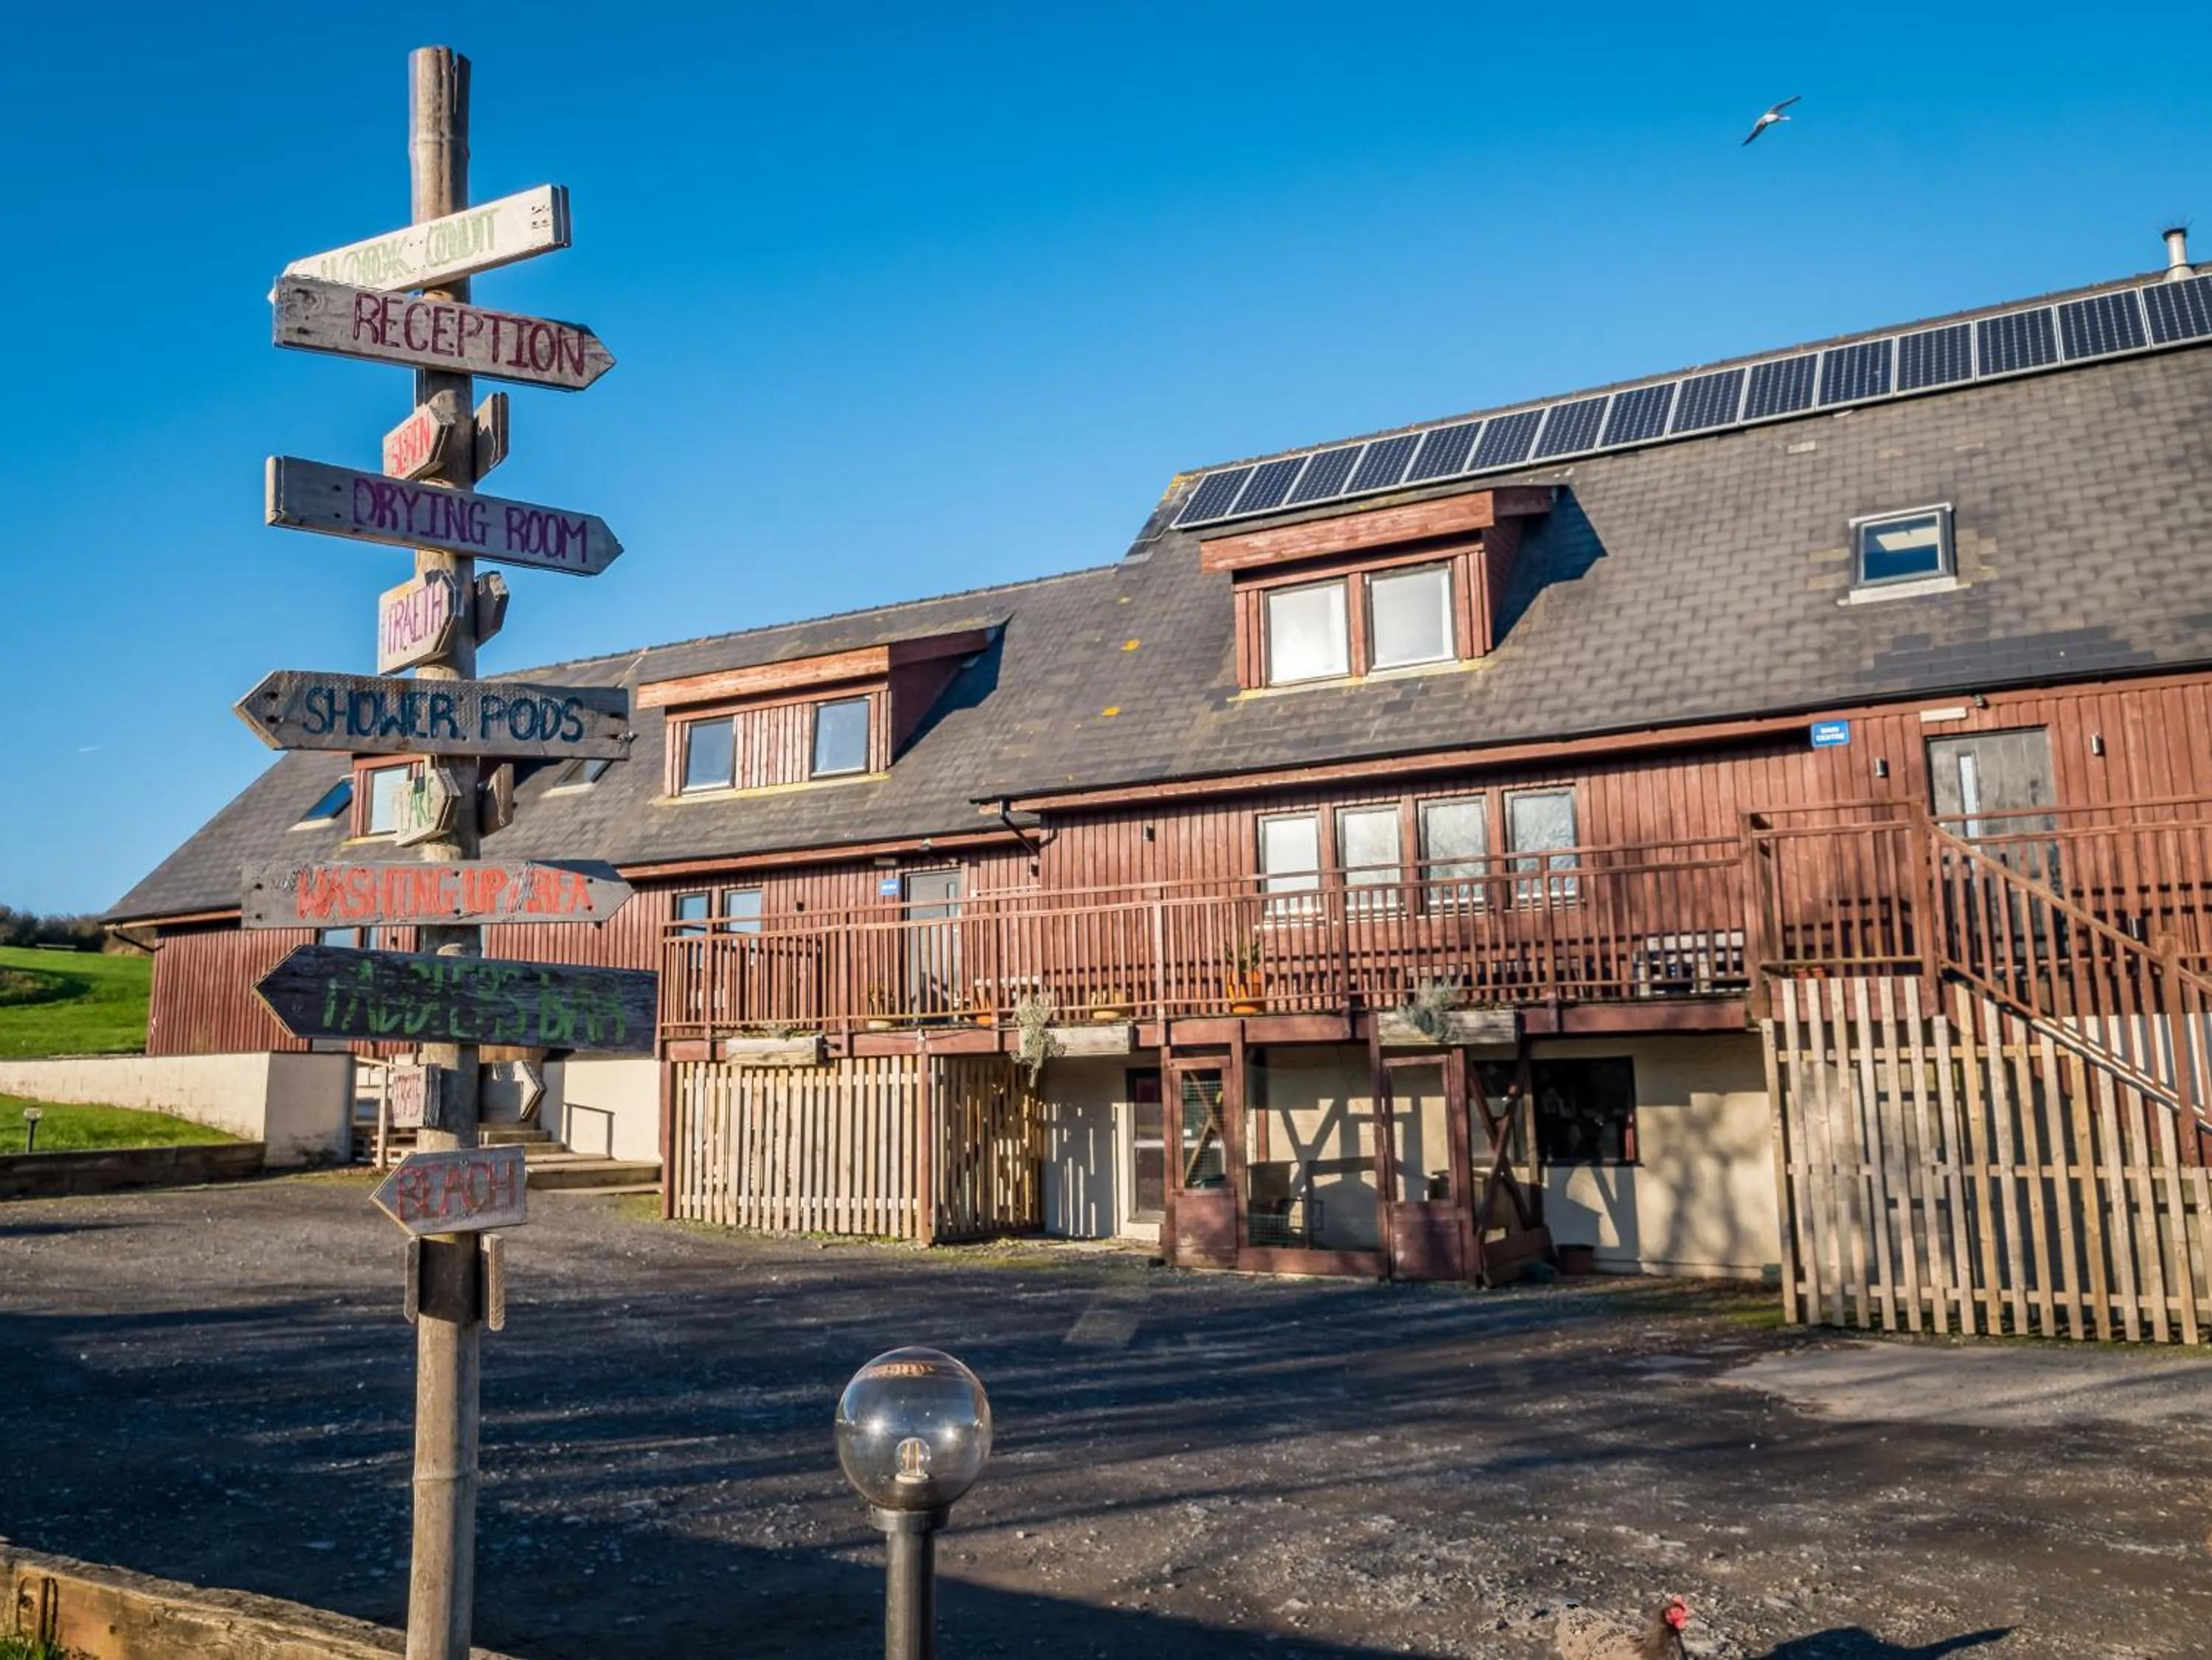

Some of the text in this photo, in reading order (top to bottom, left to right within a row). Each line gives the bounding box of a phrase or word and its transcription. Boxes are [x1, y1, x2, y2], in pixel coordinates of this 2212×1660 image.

[352, 292, 585, 377] RECEPTION
[353, 478, 588, 564] DRYING ROOM
[387, 583, 444, 655] TRAETH
[302, 686, 585, 743] SHOWER PODS
[296, 866, 593, 919] WASHING UP AREA
[397, 1159, 515, 1221] BEACH
